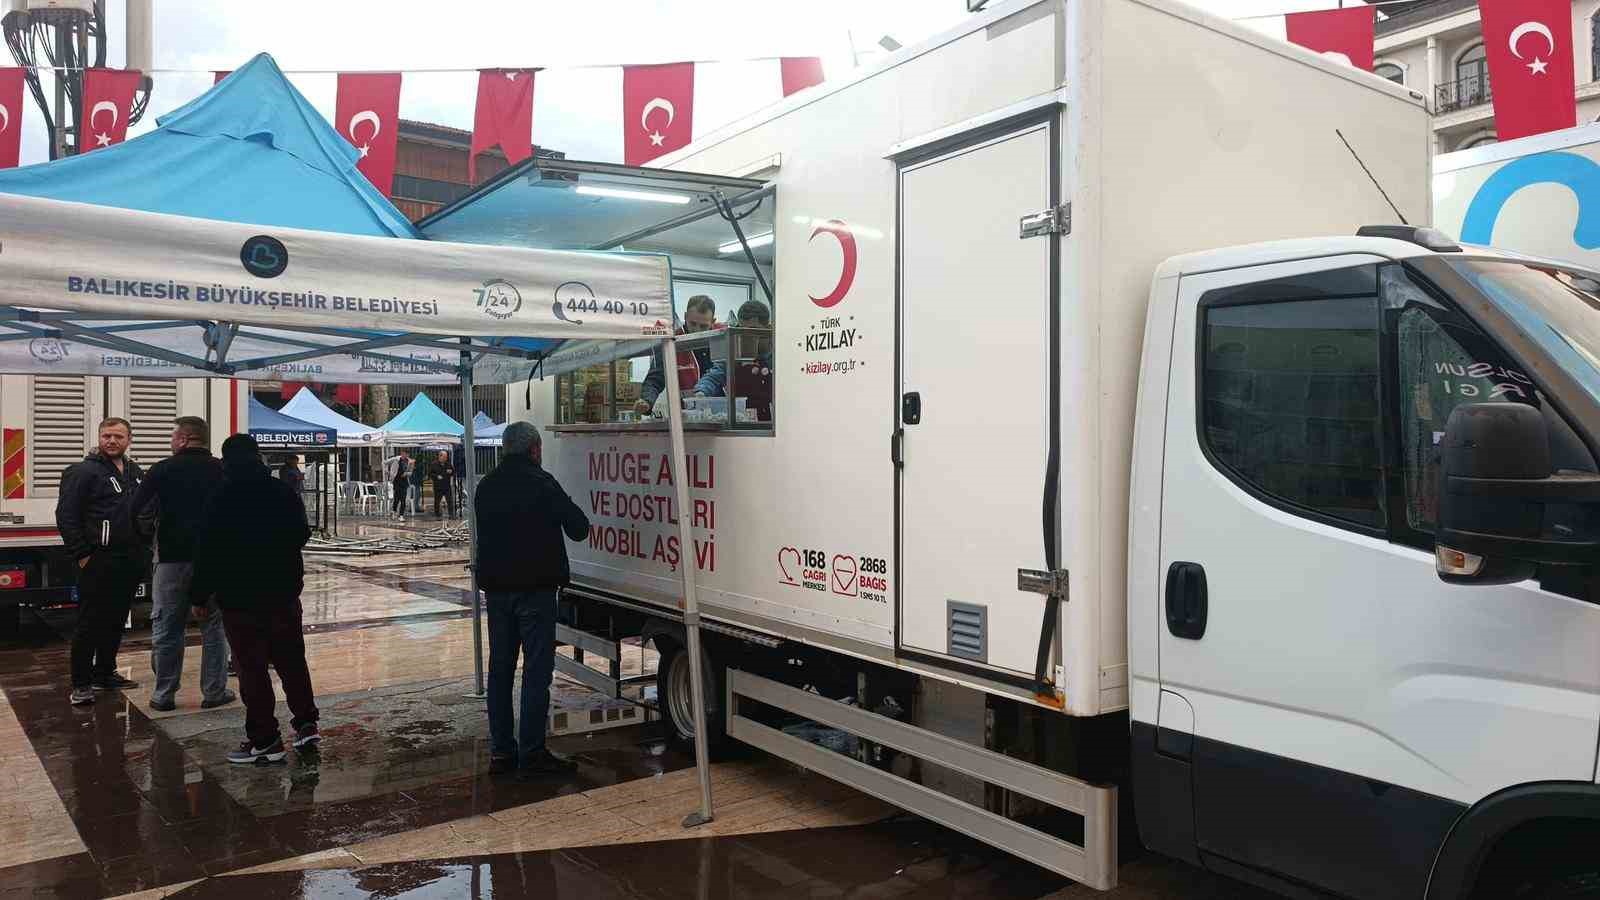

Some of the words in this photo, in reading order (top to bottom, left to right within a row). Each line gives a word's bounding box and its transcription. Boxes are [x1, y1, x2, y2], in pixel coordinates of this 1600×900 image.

[68, 276, 190, 301] BALIKESİR
[196, 284, 327, 310] BÜYÜKŞEHİR
[332, 296, 438, 316] BELEDİYESİ
[567, 298, 598, 313] 444
[603, 301, 624, 315] 40
[631, 302, 649, 316] 10
[820, 316, 841, 330] TÜRK
[806, 329, 856, 352] KIZILAY
[256, 431, 314, 443] BELEDİYESİ
[588, 446, 650, 485] MÜGE
[656, 454, 714, 489] ALI
[590, 490, 611, 517] VE
[616, 493, 715, 530] DOSTLRI
[588, 524, 647, 559] MOBİL
[652, 534, 715, 573] AŞVİ
[803, 549, 826, 570] 168
[860, 557, 886, 574] 2868
[863, 592, 873, 601] SMS
[880, 595, 887, 604] TL
